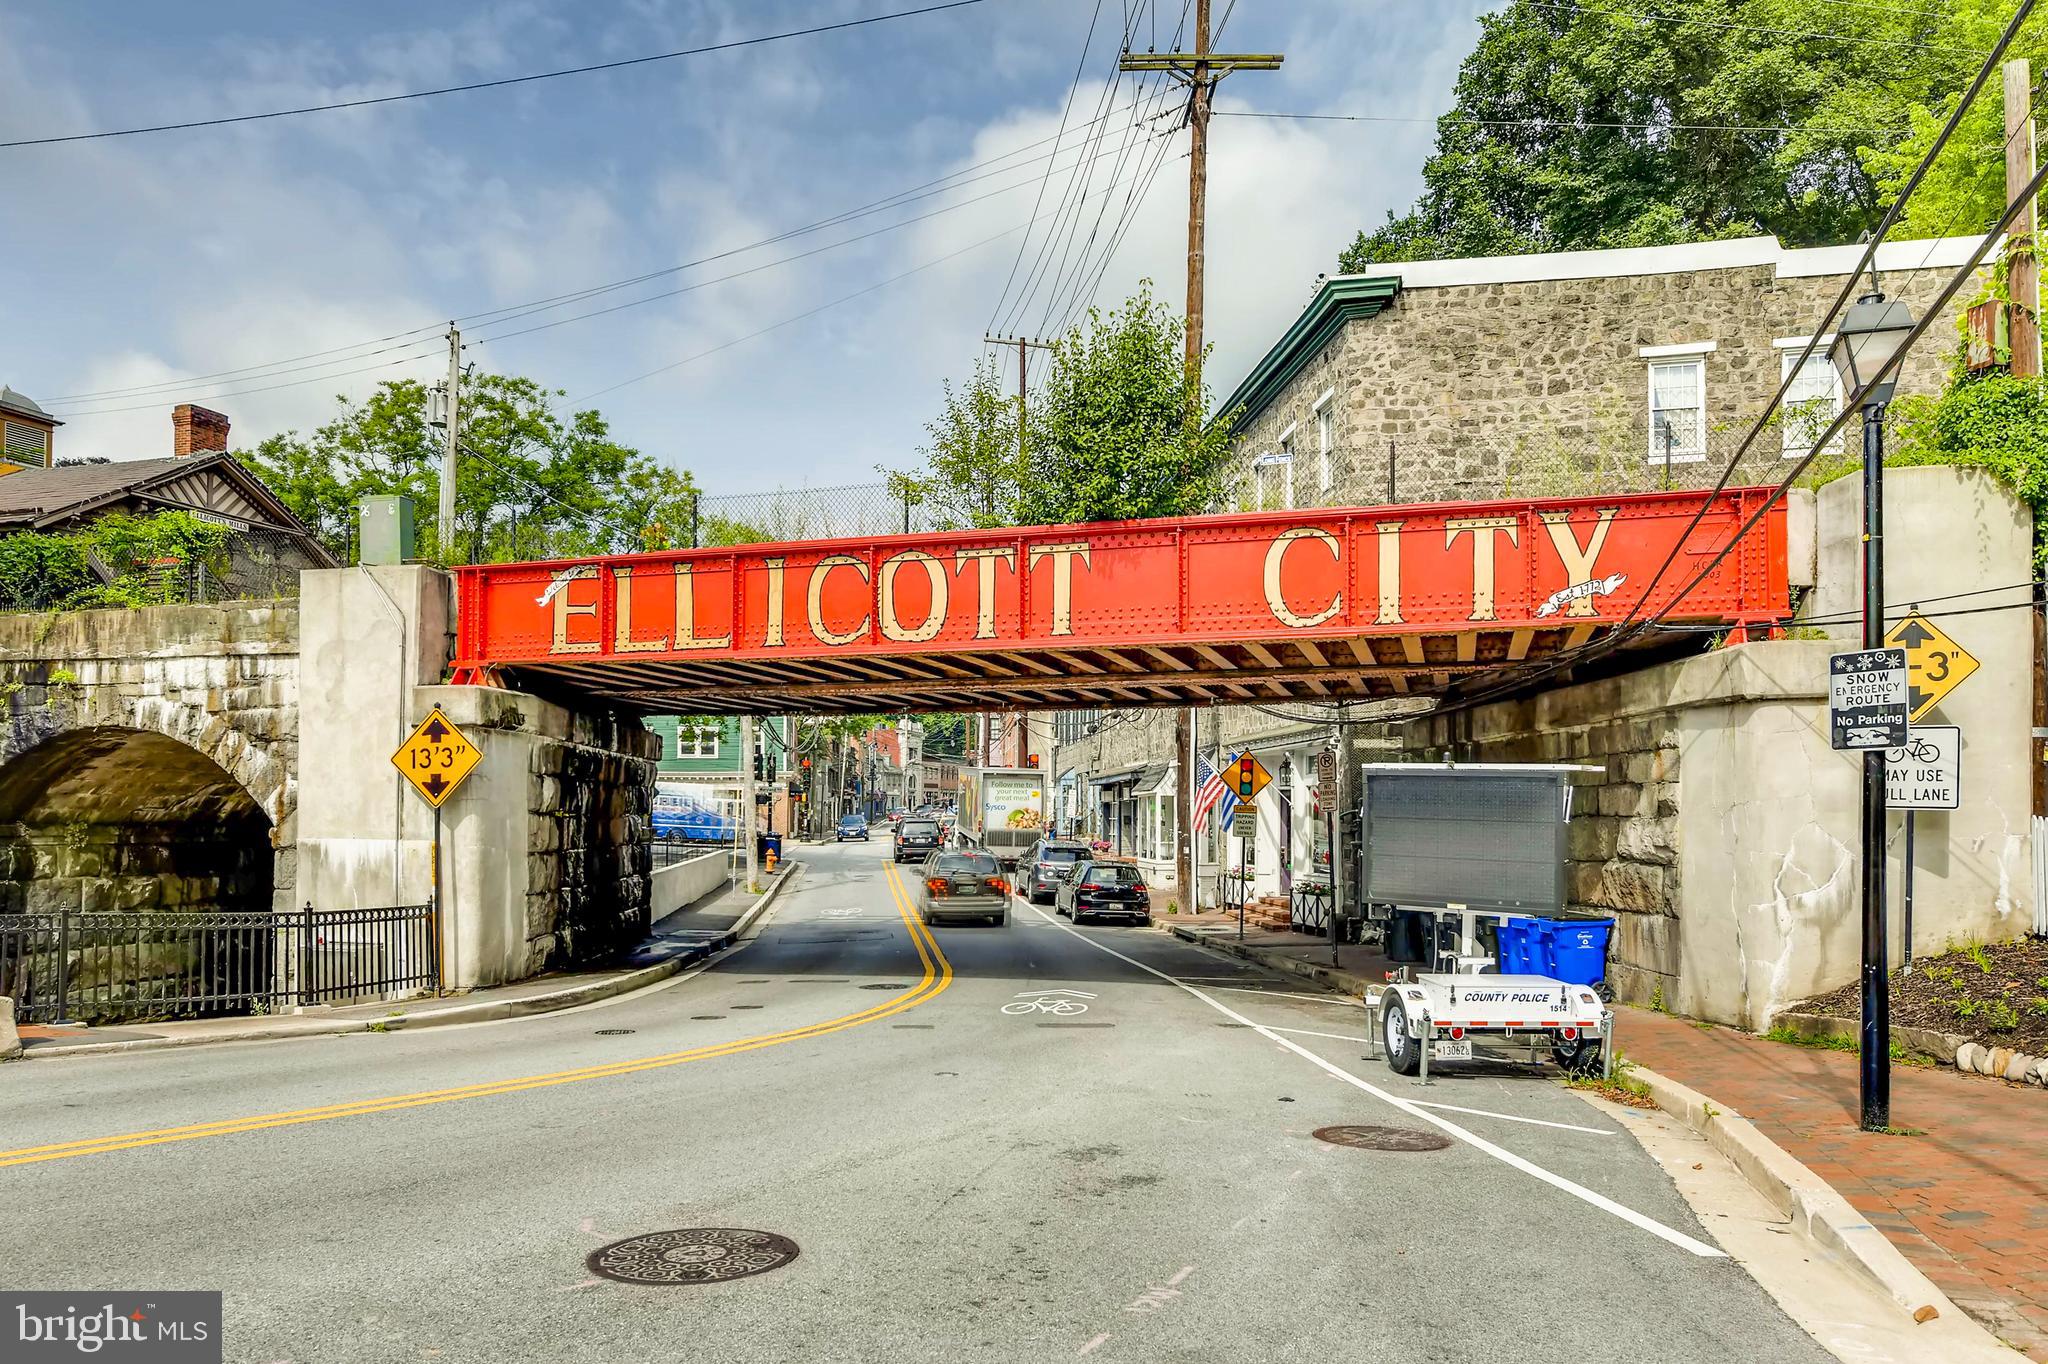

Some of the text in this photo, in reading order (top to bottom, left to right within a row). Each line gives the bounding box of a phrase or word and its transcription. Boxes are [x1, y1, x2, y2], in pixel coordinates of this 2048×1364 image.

[228, 520, 248, 530] MILLS
[549, 507, 1620, 656] ELLICOTT CITY
[1580, 581, 1602, 596] 1772
[1846, 671, 1889, 685] SNOW
[1846, 693, 1890, 706] ROUTE
[1836, 713, 1903, 727] No Parking
[1916, 769, 1944, 782] USE
[1886, 788, 1951, 801] LL LANE
[985, 802, 1007, 812] Sysco
[1464, 992, 1550, 1003] COUNTY POLICE
[1550, 1004, 1567, 1012] 1514
